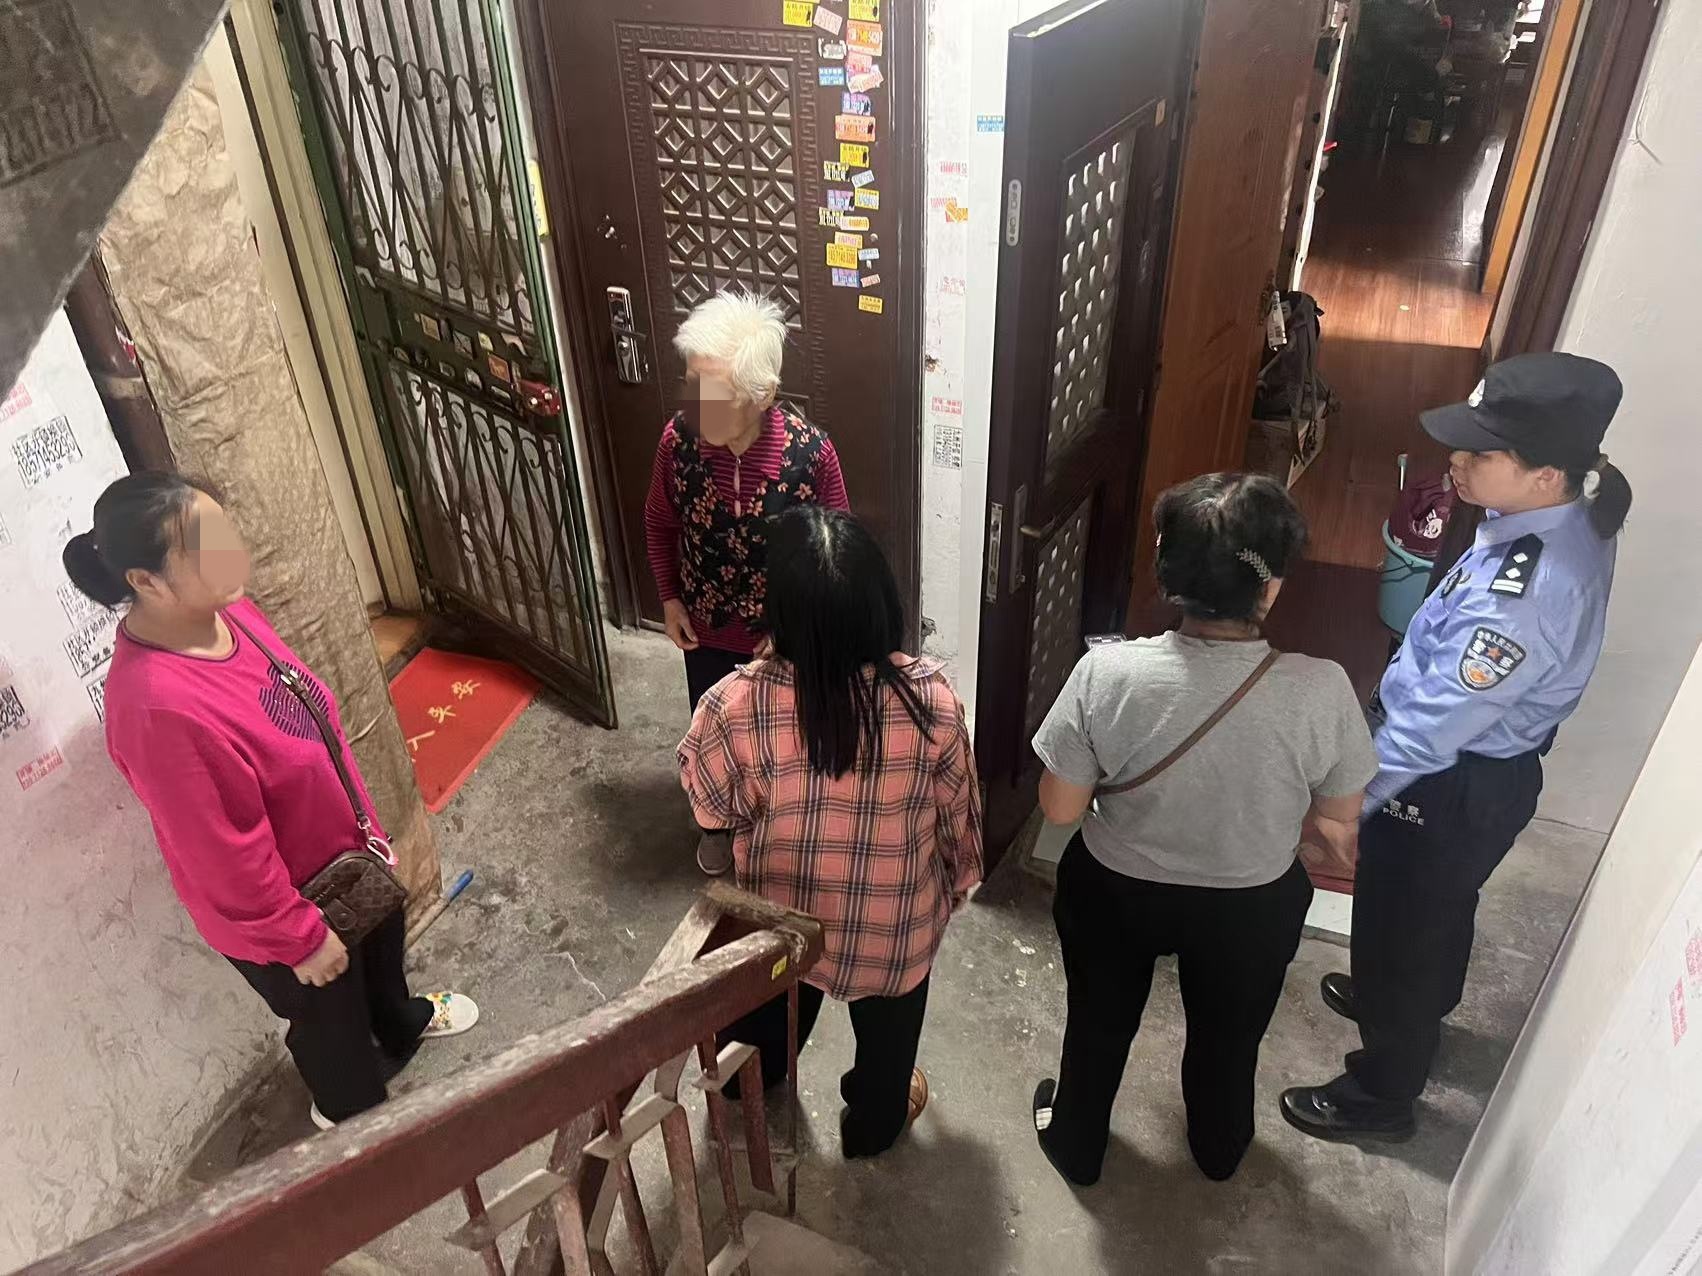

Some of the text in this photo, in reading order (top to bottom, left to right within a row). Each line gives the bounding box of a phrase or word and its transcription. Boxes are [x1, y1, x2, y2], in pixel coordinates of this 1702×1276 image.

[406, 679, 482, 763] 入平安
[1382, 807, 1425, 826] POLICE
